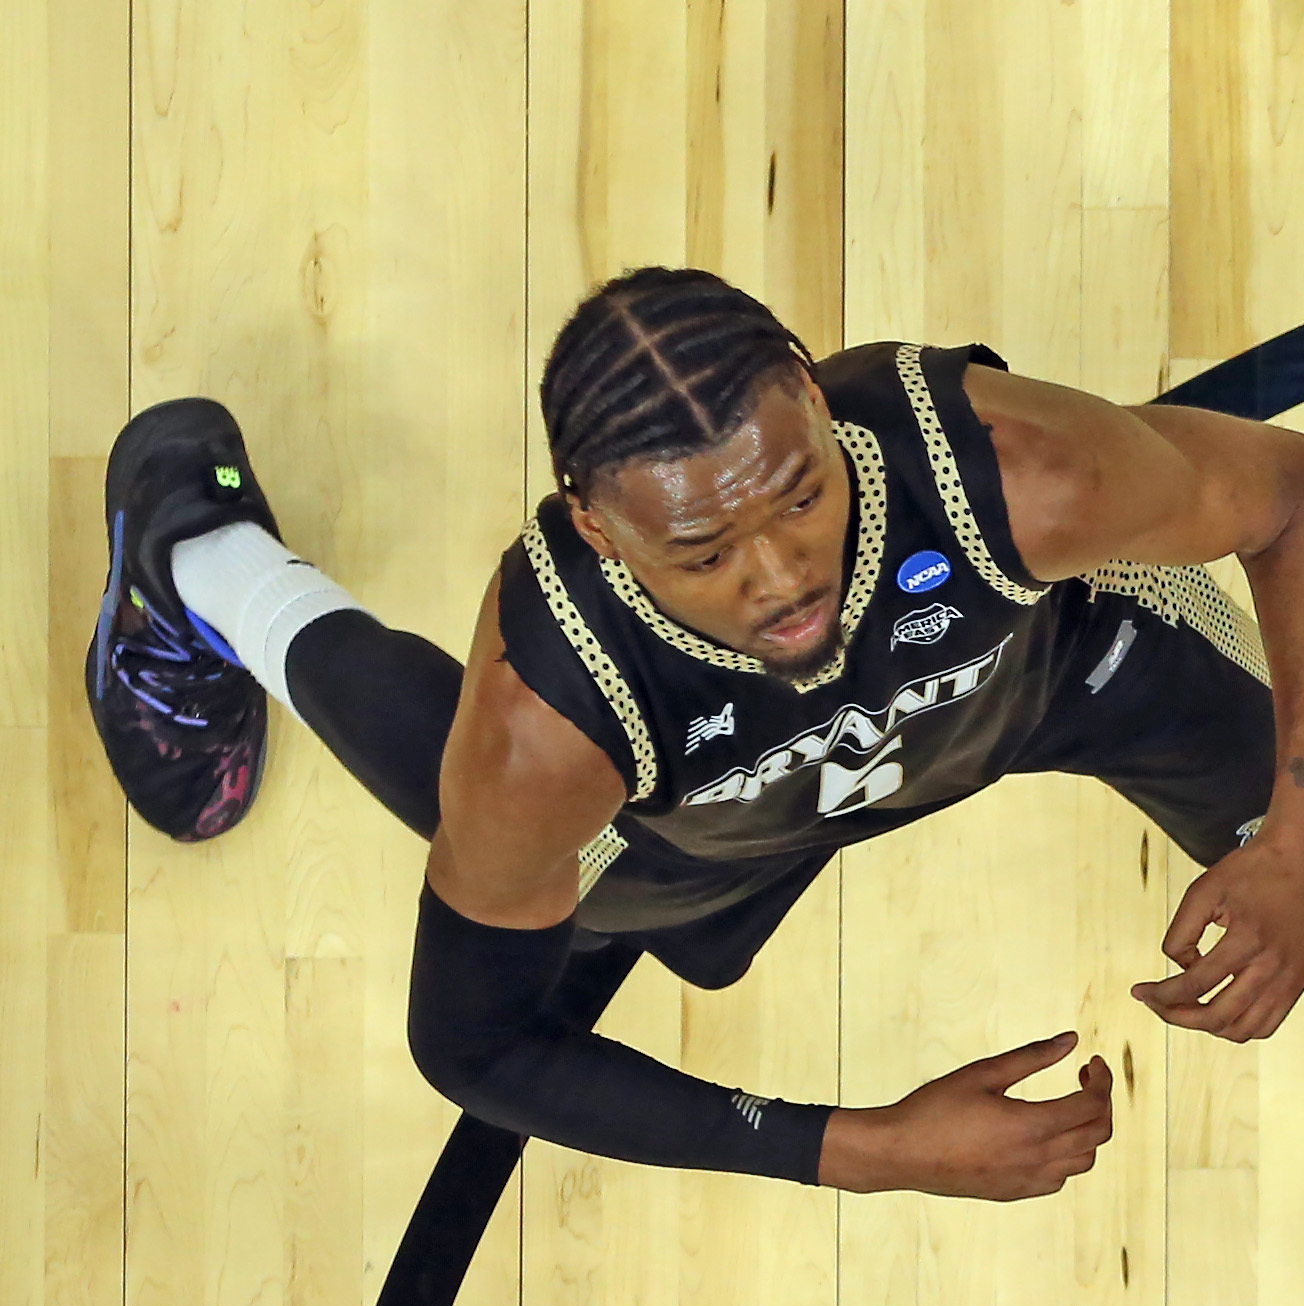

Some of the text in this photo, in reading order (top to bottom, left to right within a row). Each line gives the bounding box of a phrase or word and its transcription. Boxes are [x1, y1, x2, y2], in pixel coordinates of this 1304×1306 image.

[906, 562, 950, 589] NCAA
[903, 620, 944, 639] EAST
[687, 653, 996, 806] BRYANT
